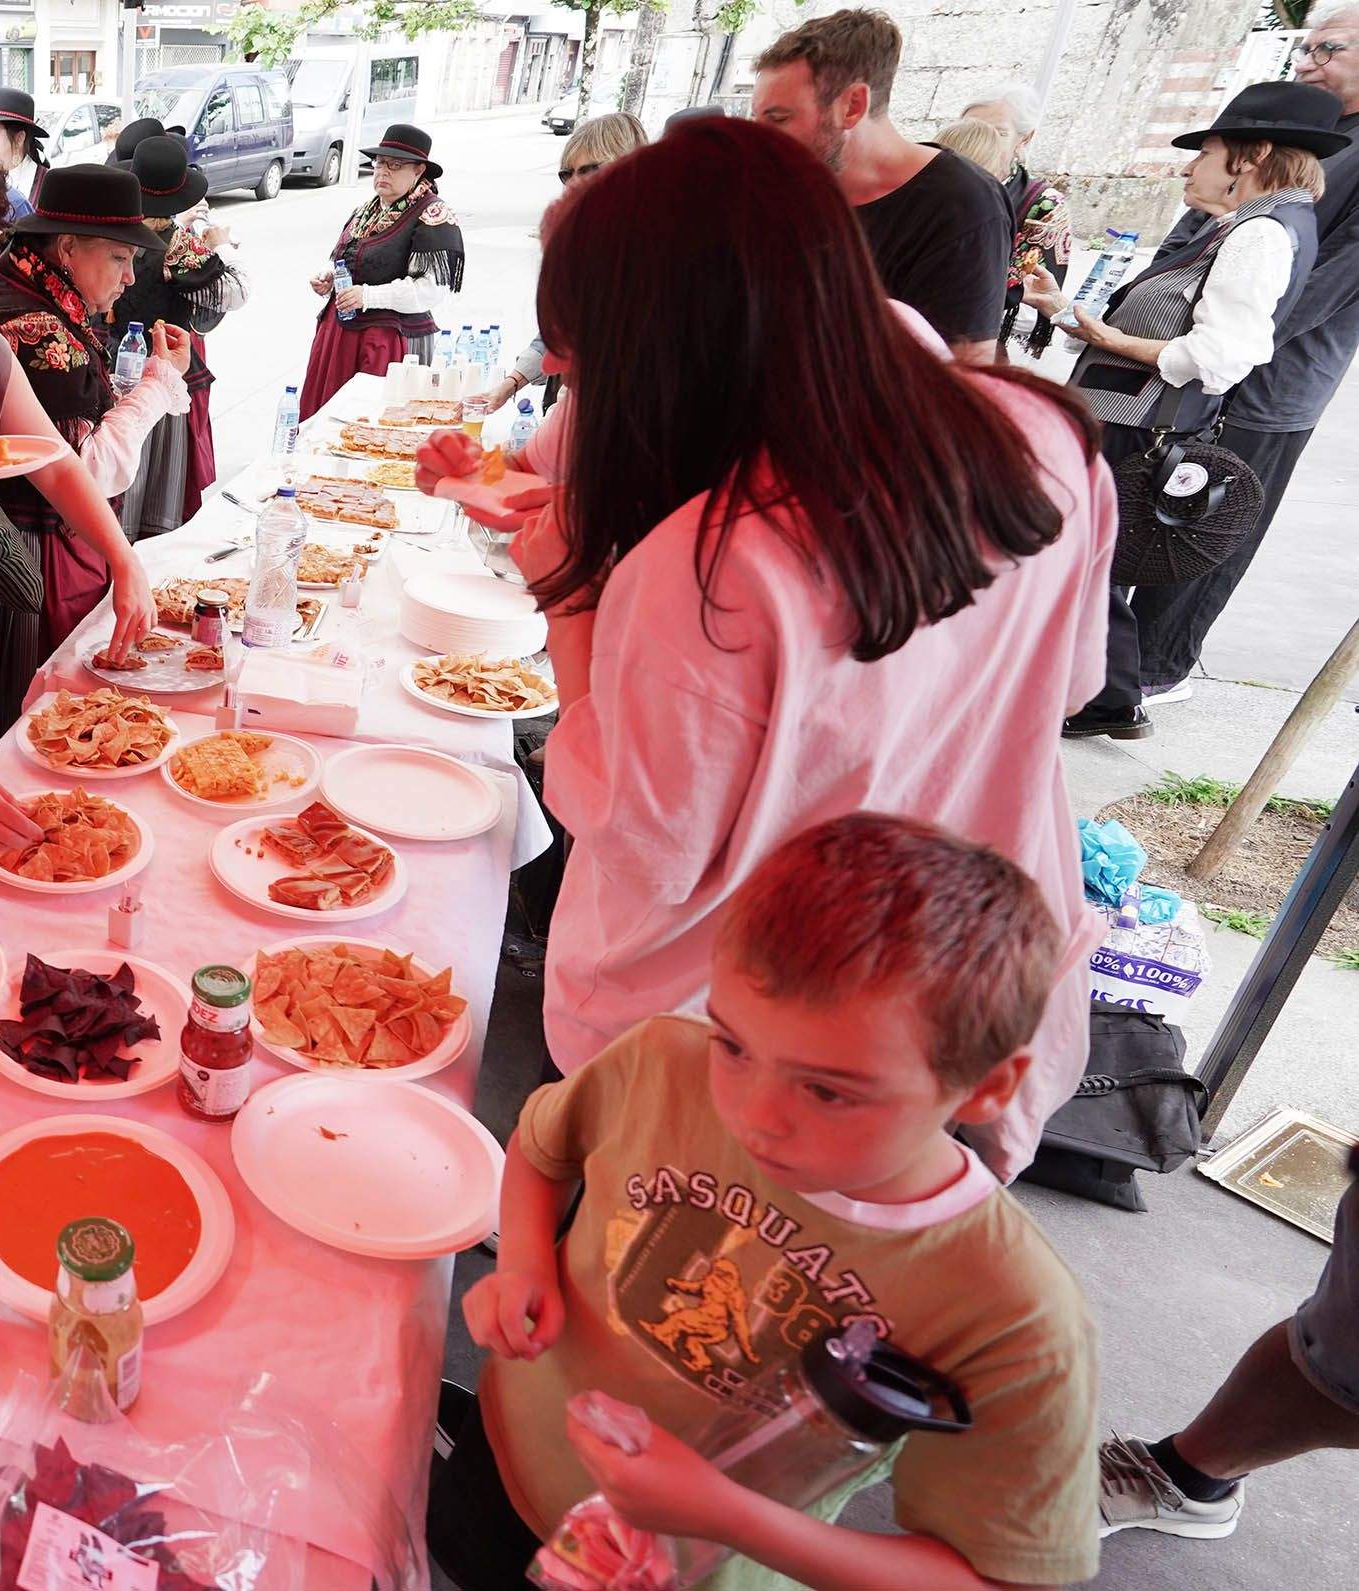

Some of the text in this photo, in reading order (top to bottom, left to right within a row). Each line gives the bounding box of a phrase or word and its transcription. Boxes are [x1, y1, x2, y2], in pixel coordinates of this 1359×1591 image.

[1091, 953, 1121, 971] 0%
[1135, 965, 1189, 989] 100%
[626, 1165, 891, 1342] SASQUATC
